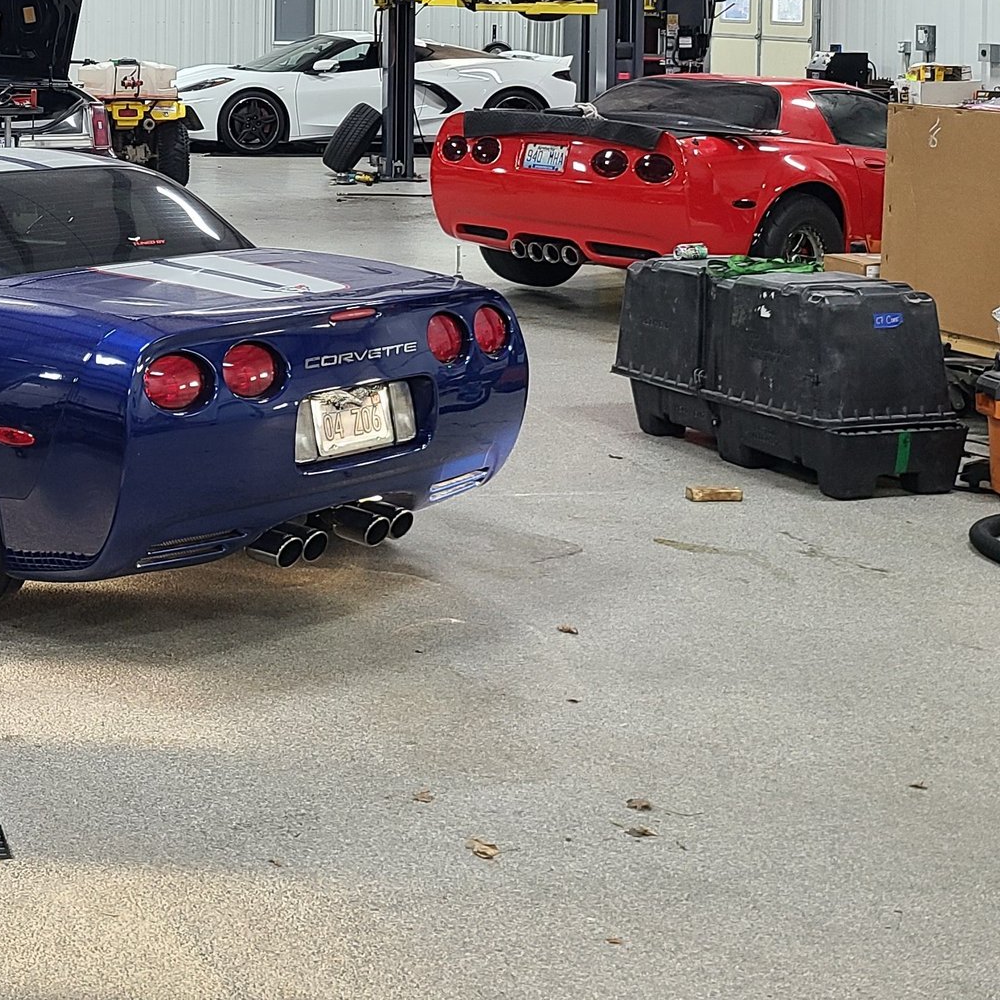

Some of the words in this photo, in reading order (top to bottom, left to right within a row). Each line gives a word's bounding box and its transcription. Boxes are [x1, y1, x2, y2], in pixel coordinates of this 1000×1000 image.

[526, 149, 543, 164] 940
[304, 341, 418, 369] CORVETTE
[323, 412, 345, 442] 04
[350, 404, 382, 437] Z06
